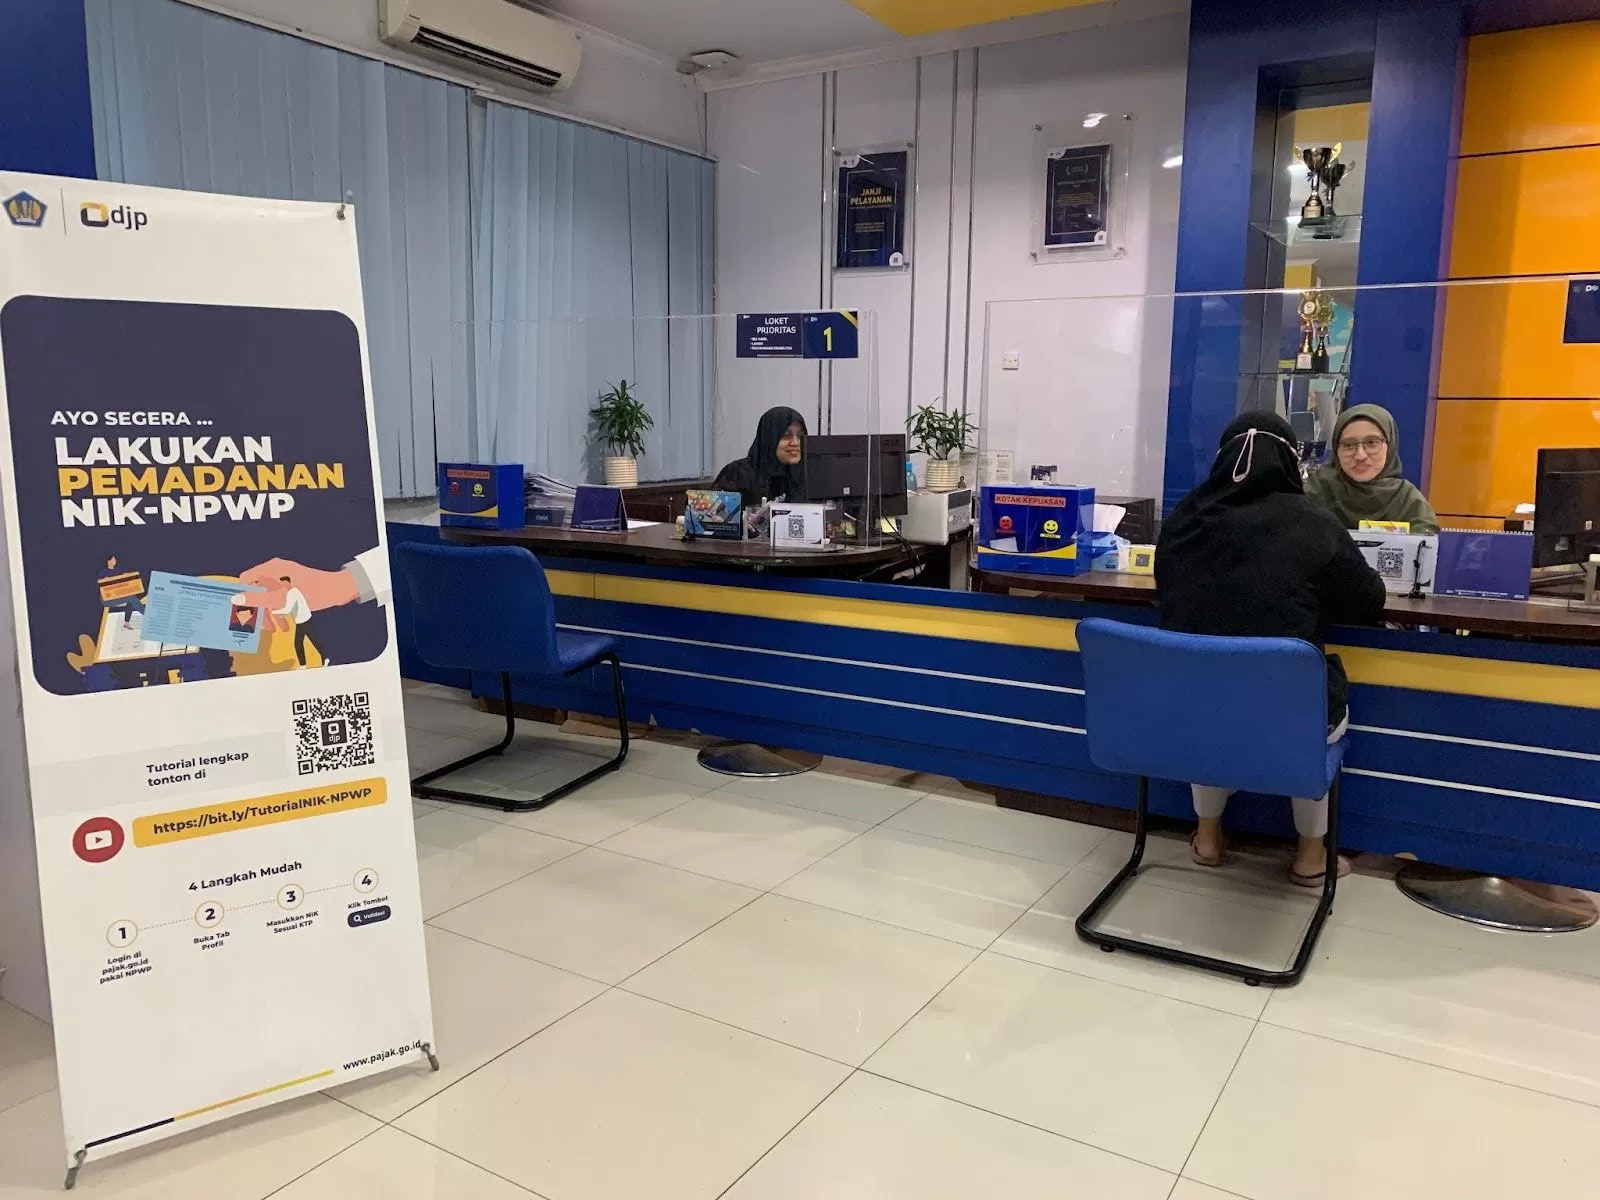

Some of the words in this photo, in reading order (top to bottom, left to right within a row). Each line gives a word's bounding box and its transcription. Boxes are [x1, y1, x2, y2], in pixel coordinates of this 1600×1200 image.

[861, 188, 881, 196] JANJI
[850, 196, 892, 205] PELAYANAN
[111, 207, 148, 231] djp
[764, 317, 789, 325] LOKET
[756, 326, 797, 334] PRIORITAS
[823, 326, 833, 352] 1
[51, 411, 98, 426] AYO
[104, 411, 191, 426] SEGERA
[55, 436, 273, 466] LAKUKAN
[57, 463, 345, 496] PEMADANAN
[996, 495, 1021, 503] KOTAK
[1023, 497, 1064, 506] KEPUASAN
[61, 493, 295, 528] NIK-NPWP
[146, 757, 196, 773] Tutorial
[199, 751, 249, 768] lengkap
[147, 773, 191, 787] tonton
[195, 769, 206, 779] di
[153, 787, 372, 835] https://bit.ly/TutorialNIK-NPWP
[189, 882, 198, 891] 4
[201, 870, 257, 887] Langkah
[260, 861, 301, 876] Mudah
[361, 875, 372, 886] 4
[286, 891, 296, 903] 3
[205, 908, 216, 921] 2
[266, 915, 304, 927] Masukkan
[306, 911, 319, 919] NIK
[118, 927, 127, 940] 1
[274, 924, 298, 934] Sesuai
[300, 920, 313, 928] KTP
[193, 936, 214, 944] Buka
[216, 931, 230, 939] Tab
[202, 941, 224, 950] Profil
[102, 958, 149, 975] pajak.go.id
[107, 954, 131, 965] Login
[100, 973, 123, 984] pakai
[125, 966, 152, 977] NPWP
[343, 1040, 421, 1070] www.pajak.go.id
